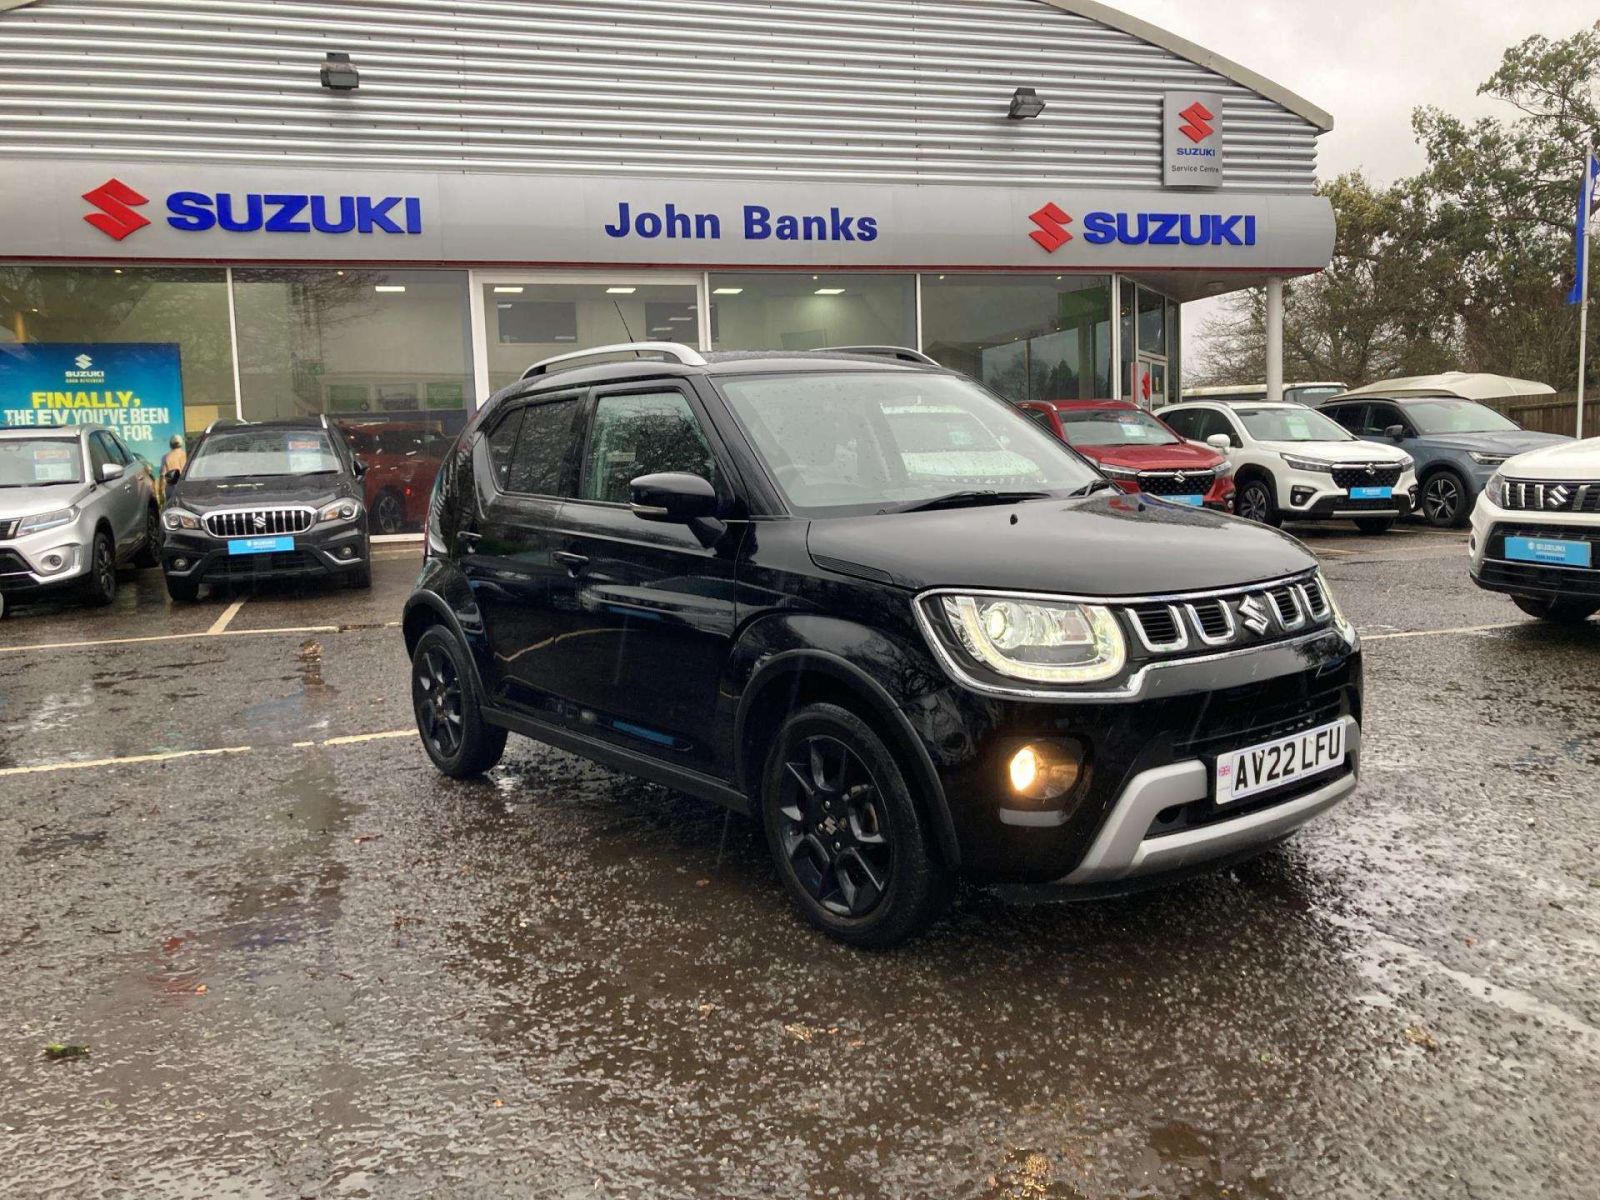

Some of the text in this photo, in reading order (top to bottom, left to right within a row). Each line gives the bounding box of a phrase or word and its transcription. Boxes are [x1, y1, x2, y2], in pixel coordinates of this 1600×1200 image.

[1176, 147, 1216, 157] SUZUKI
[1199, 165, 1219, 173] Centre
[166, 191, 422, 234] SUZUKI
[605, 202, 878, 242] John Banks
[1083, 211, 1256, 246] SUZUKI
[65, 370, 105, 378] SUZUKI
[31, 391, 141, 409] FINALLY,
[4, 407, 170, 426] THE EV YOU'VE BEEN
[123, 425, 154, 441] FOR
[1234, 726, 1341, 791] AV22 LFU
